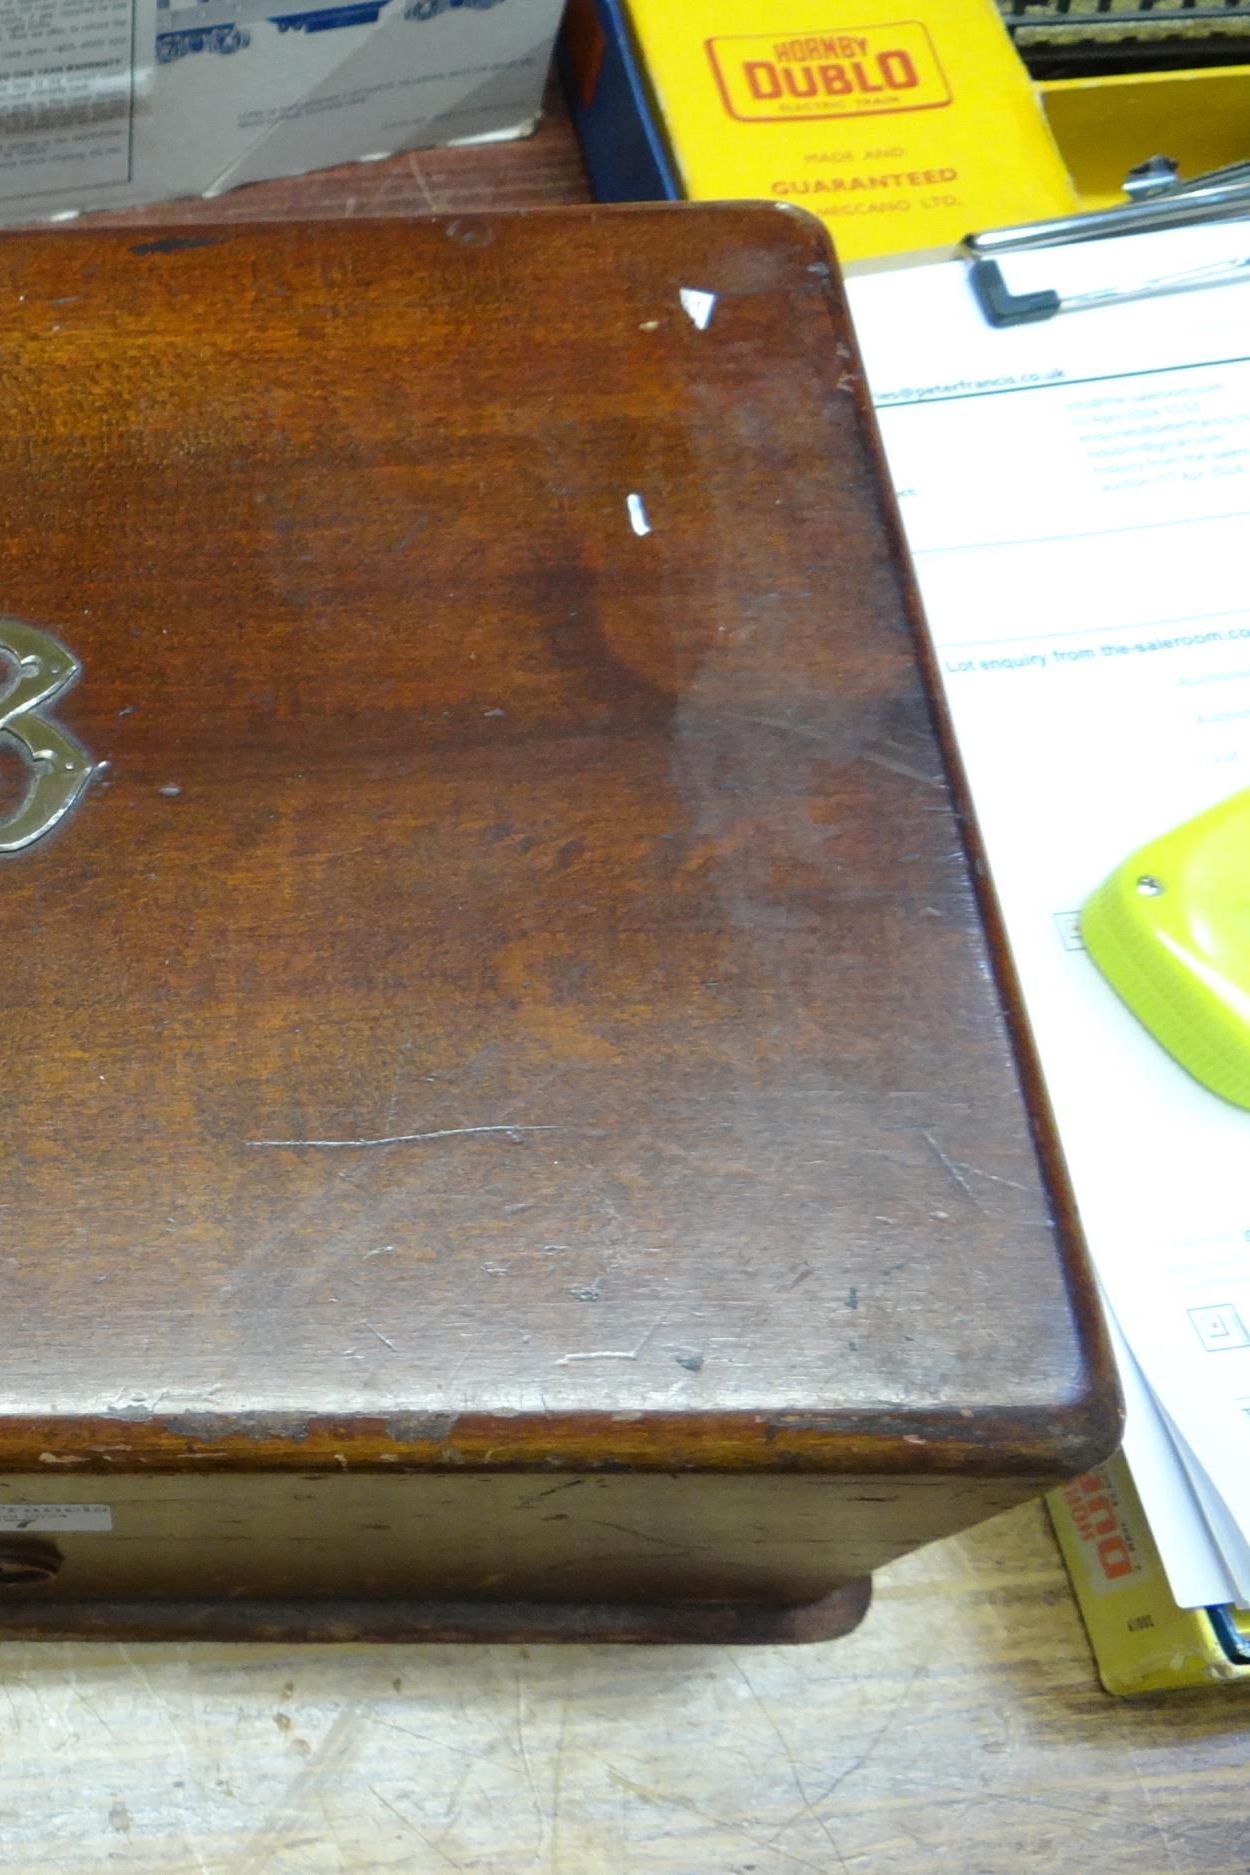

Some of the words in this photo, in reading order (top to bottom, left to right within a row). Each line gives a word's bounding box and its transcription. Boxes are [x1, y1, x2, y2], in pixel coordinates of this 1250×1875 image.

[772, 36, 868, 62] HORNBY
[742, 49, 919, 101] DUBLO
[804, 151, 854, 164] MADE
[863, 147, 905, 161] AND
[771, 167, 958, 196] GUARANTEED
[944, 659, 976, 674] Lot
[980, 653, 1048, 670] enquiry
[1051, 648, 1095, 662] from
